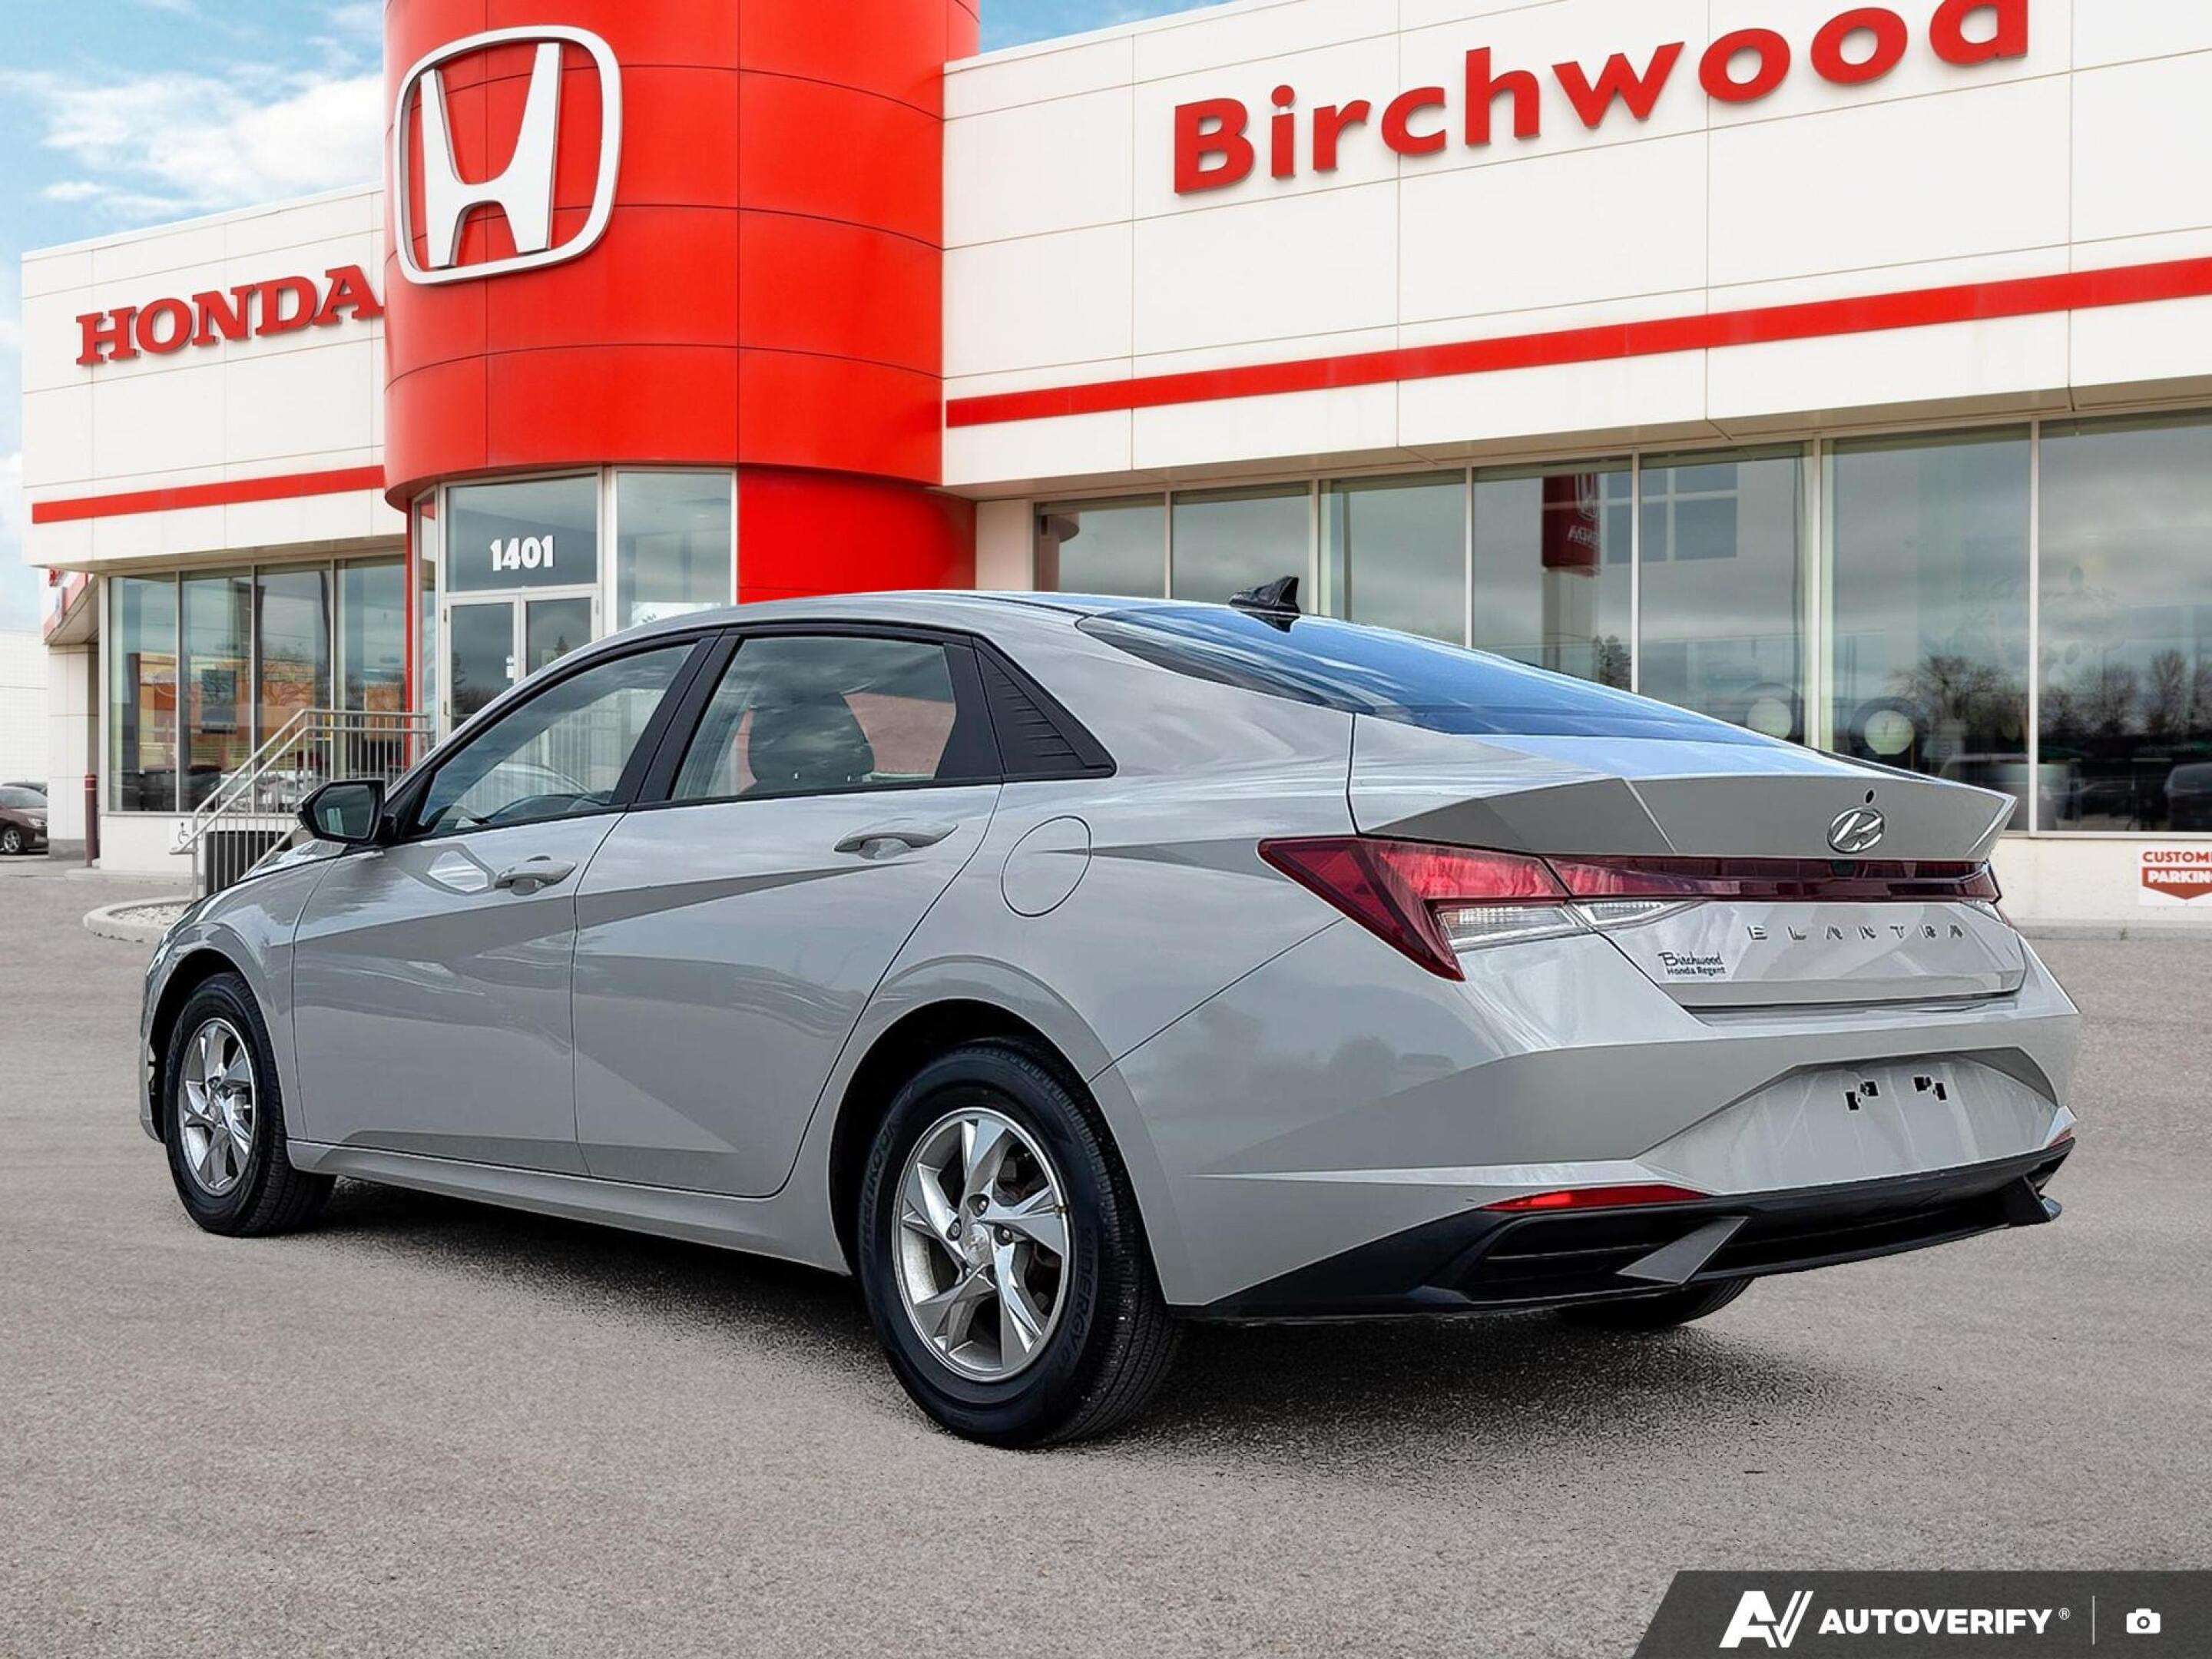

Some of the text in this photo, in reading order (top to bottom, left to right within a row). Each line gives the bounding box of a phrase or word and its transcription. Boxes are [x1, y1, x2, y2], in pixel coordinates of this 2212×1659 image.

[1174, 0, 2029, 194] Birchwood
[76, 264, 384, 366] HONDA
[490, 535, 553, 571] 1401
[2143, 852, 2212, 863] CUSTOM
[2147, 869, 2212, 883] PARKIN
[1747, 926, 1963, 940] ELANTRA
